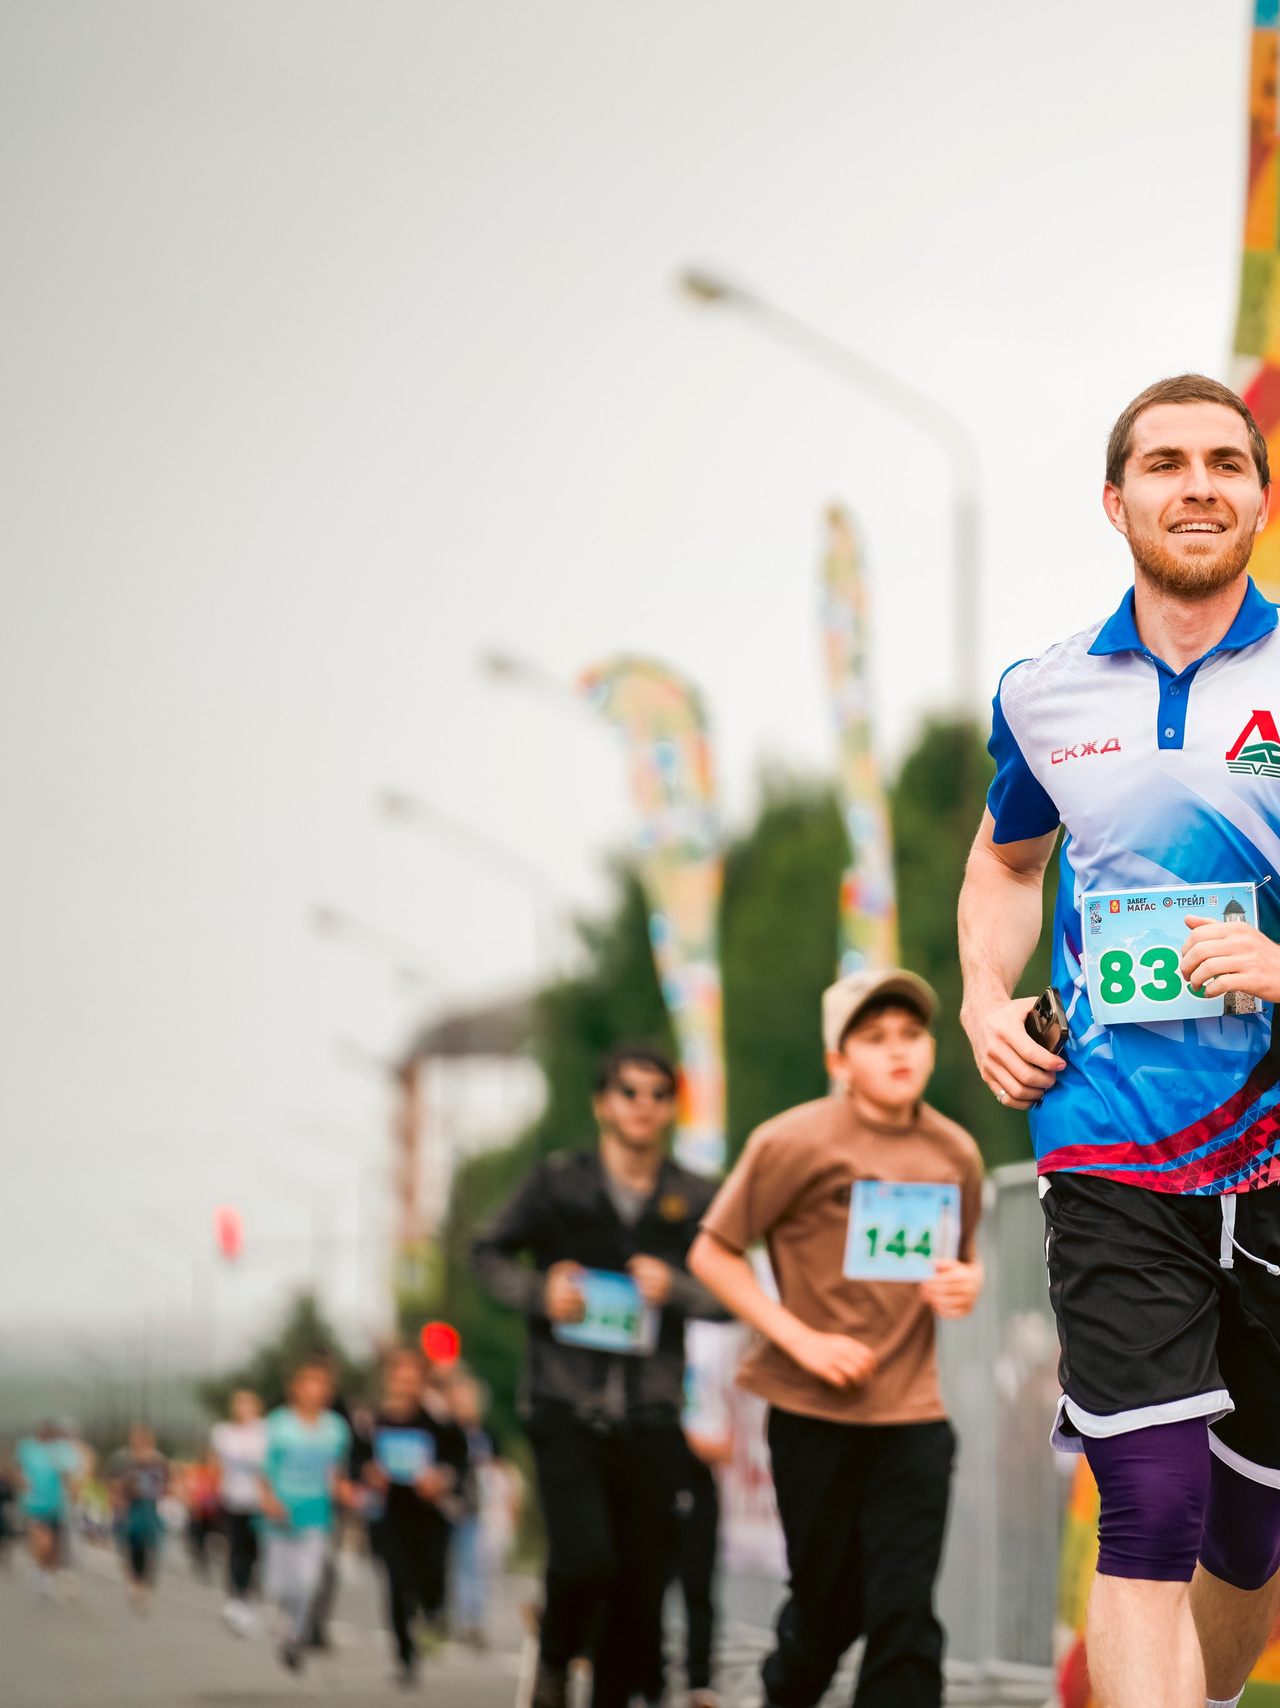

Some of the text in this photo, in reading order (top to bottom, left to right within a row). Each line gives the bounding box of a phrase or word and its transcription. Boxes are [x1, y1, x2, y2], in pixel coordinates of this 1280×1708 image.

[1051, 737, 1121, 764] СКЖД
[1127, 903, 1156, 912] МАГАС
[1099, 947, 1222, 1005] 83
[863, 1226, 933, 1259] 144
